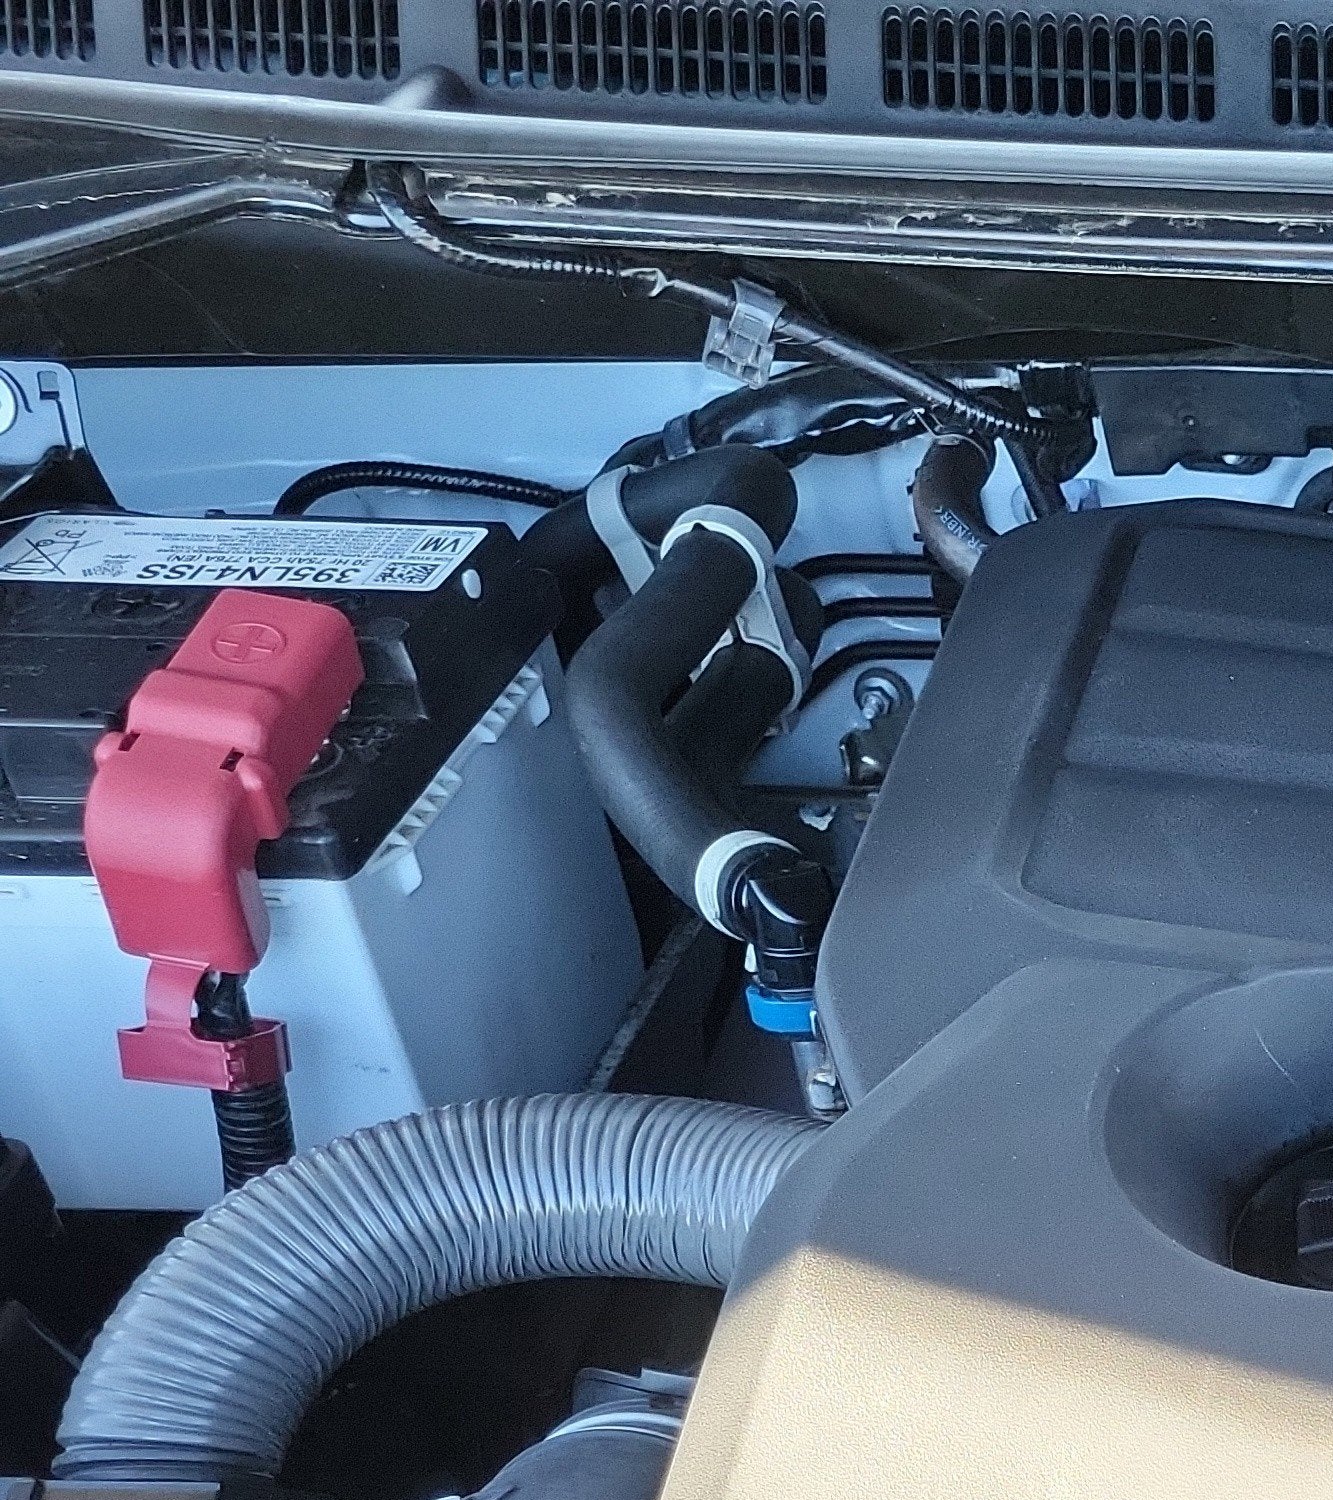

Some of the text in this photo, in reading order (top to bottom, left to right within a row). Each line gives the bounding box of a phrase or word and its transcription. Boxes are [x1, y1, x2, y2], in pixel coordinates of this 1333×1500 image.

[420, 536, 462, 550] VM
[248, 556, 284, 564] CCA
[136, 563, 361, 584] 395LN4-ISS
